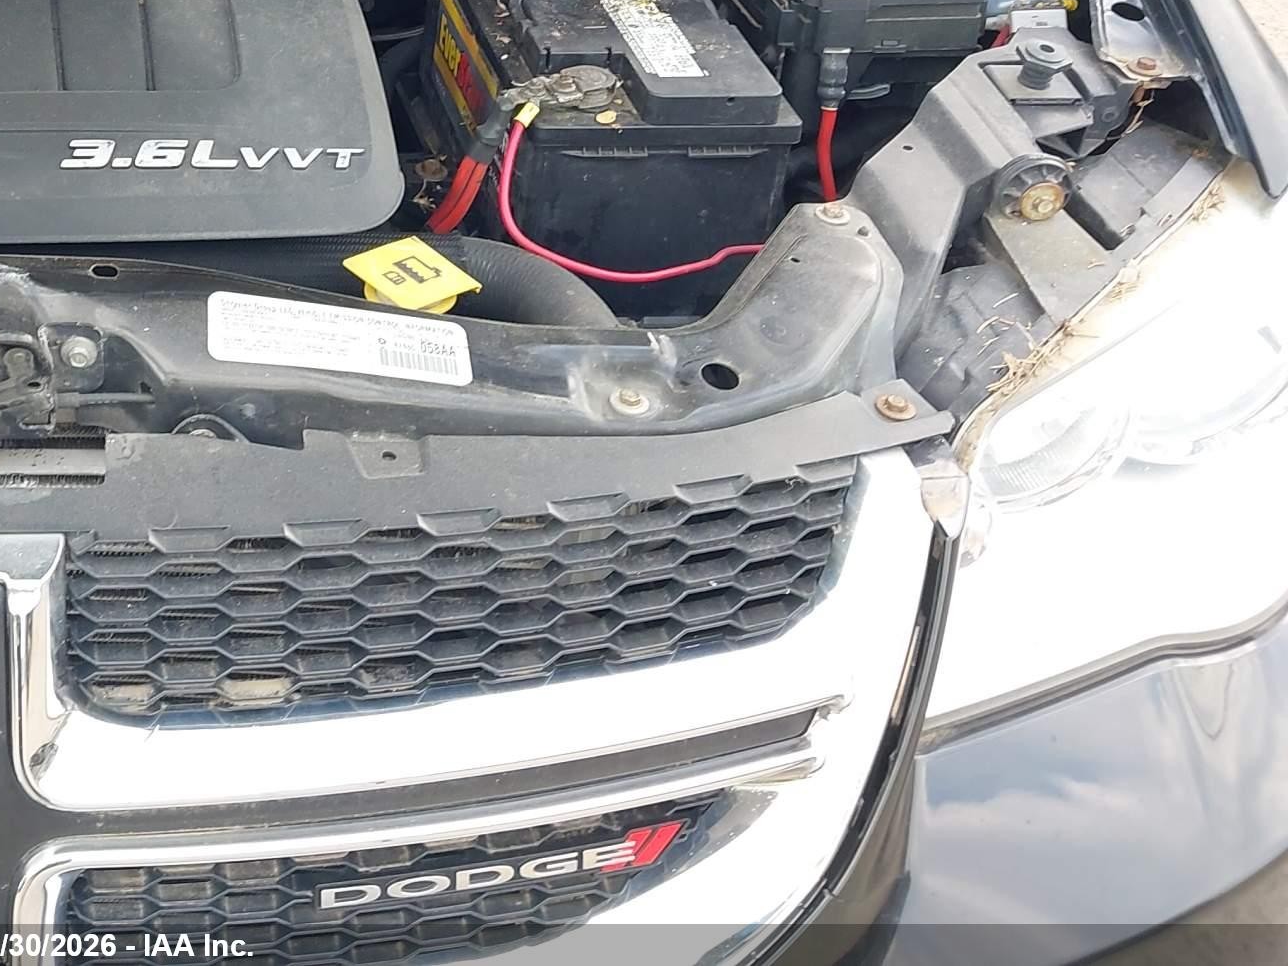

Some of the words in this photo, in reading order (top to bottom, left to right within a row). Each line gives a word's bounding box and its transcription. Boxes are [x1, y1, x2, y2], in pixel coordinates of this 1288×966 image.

[60, 139, 239, 169] 3.6L
[239, 146, 365, 169] VVT
[319, 841, 636, 909] DODGE
